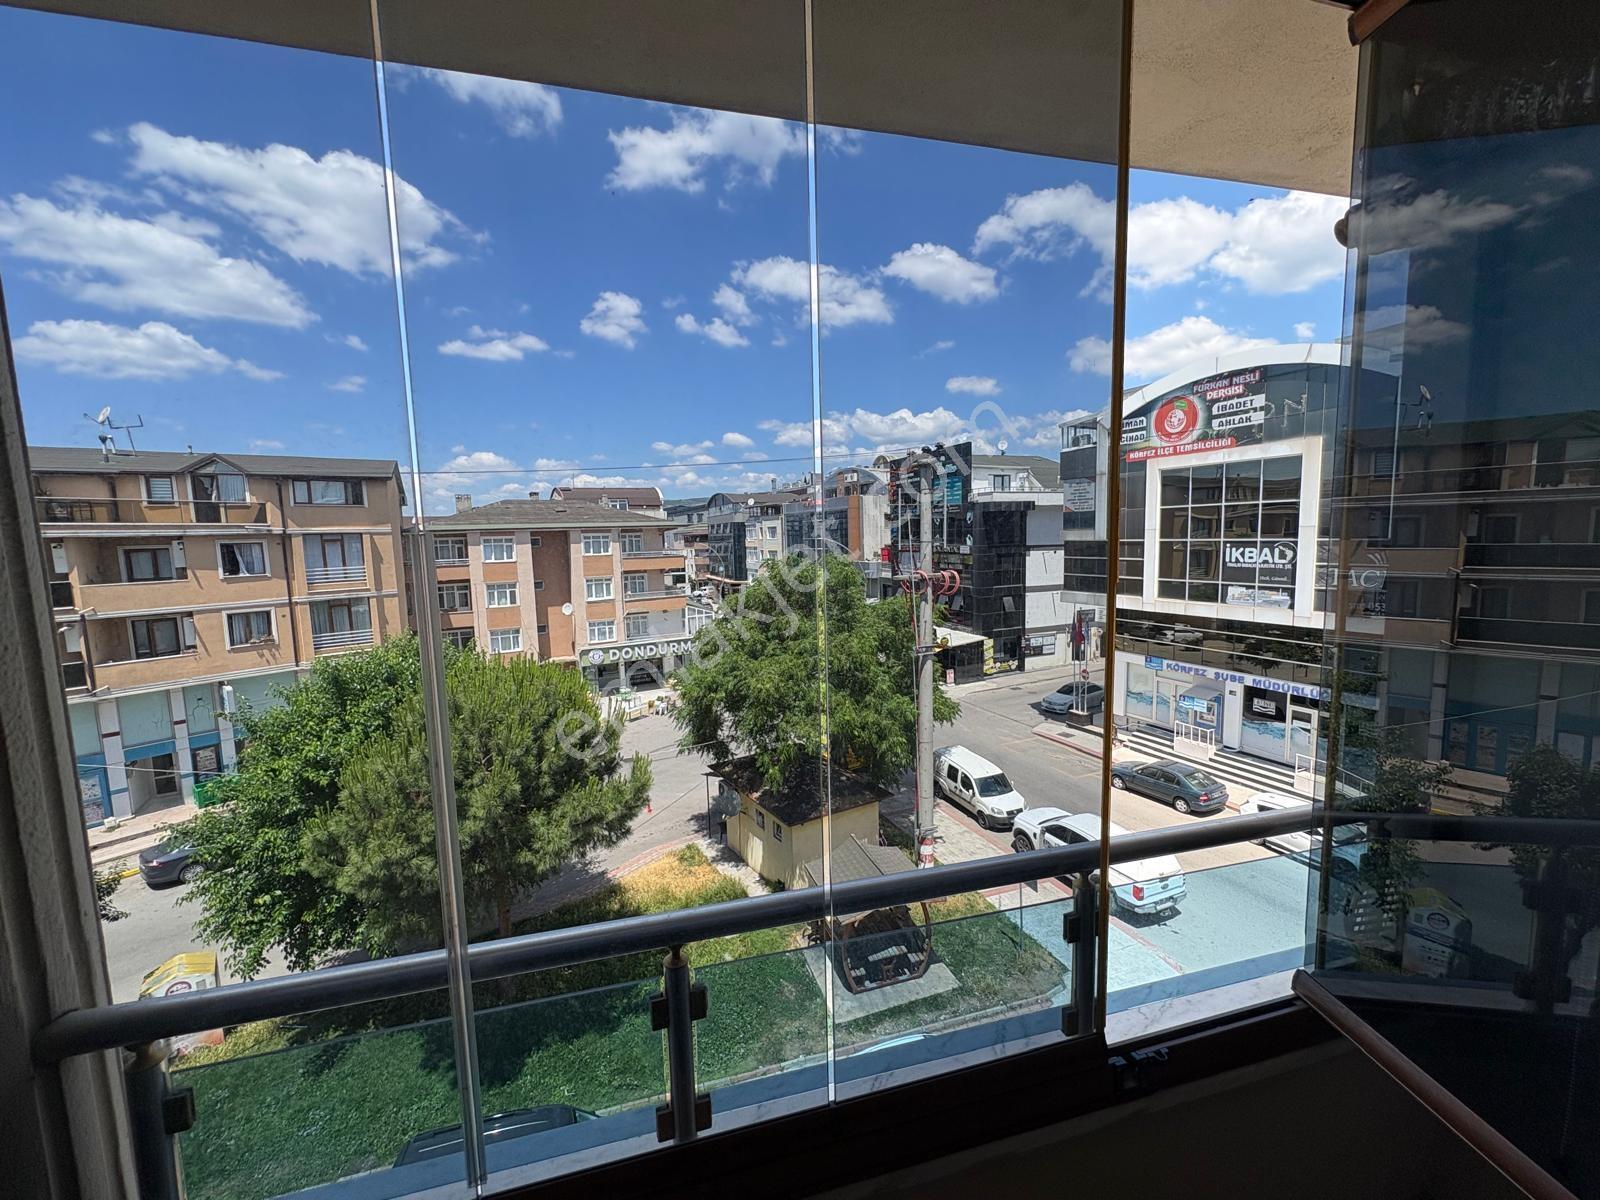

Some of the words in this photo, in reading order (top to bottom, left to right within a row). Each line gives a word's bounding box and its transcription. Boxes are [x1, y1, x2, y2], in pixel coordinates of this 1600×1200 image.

[1193, 378, 1231, 393] FURKAN
[1217, 415, 1252, 428] AHLAK
[1225, 543, 1289, 564] İKBAL
[609, 640, 693, 661] DONDURM
[1166, 662, 1208, 677] KÖRFEZ
[1213, 671, 1245, 684] ŞUBE
